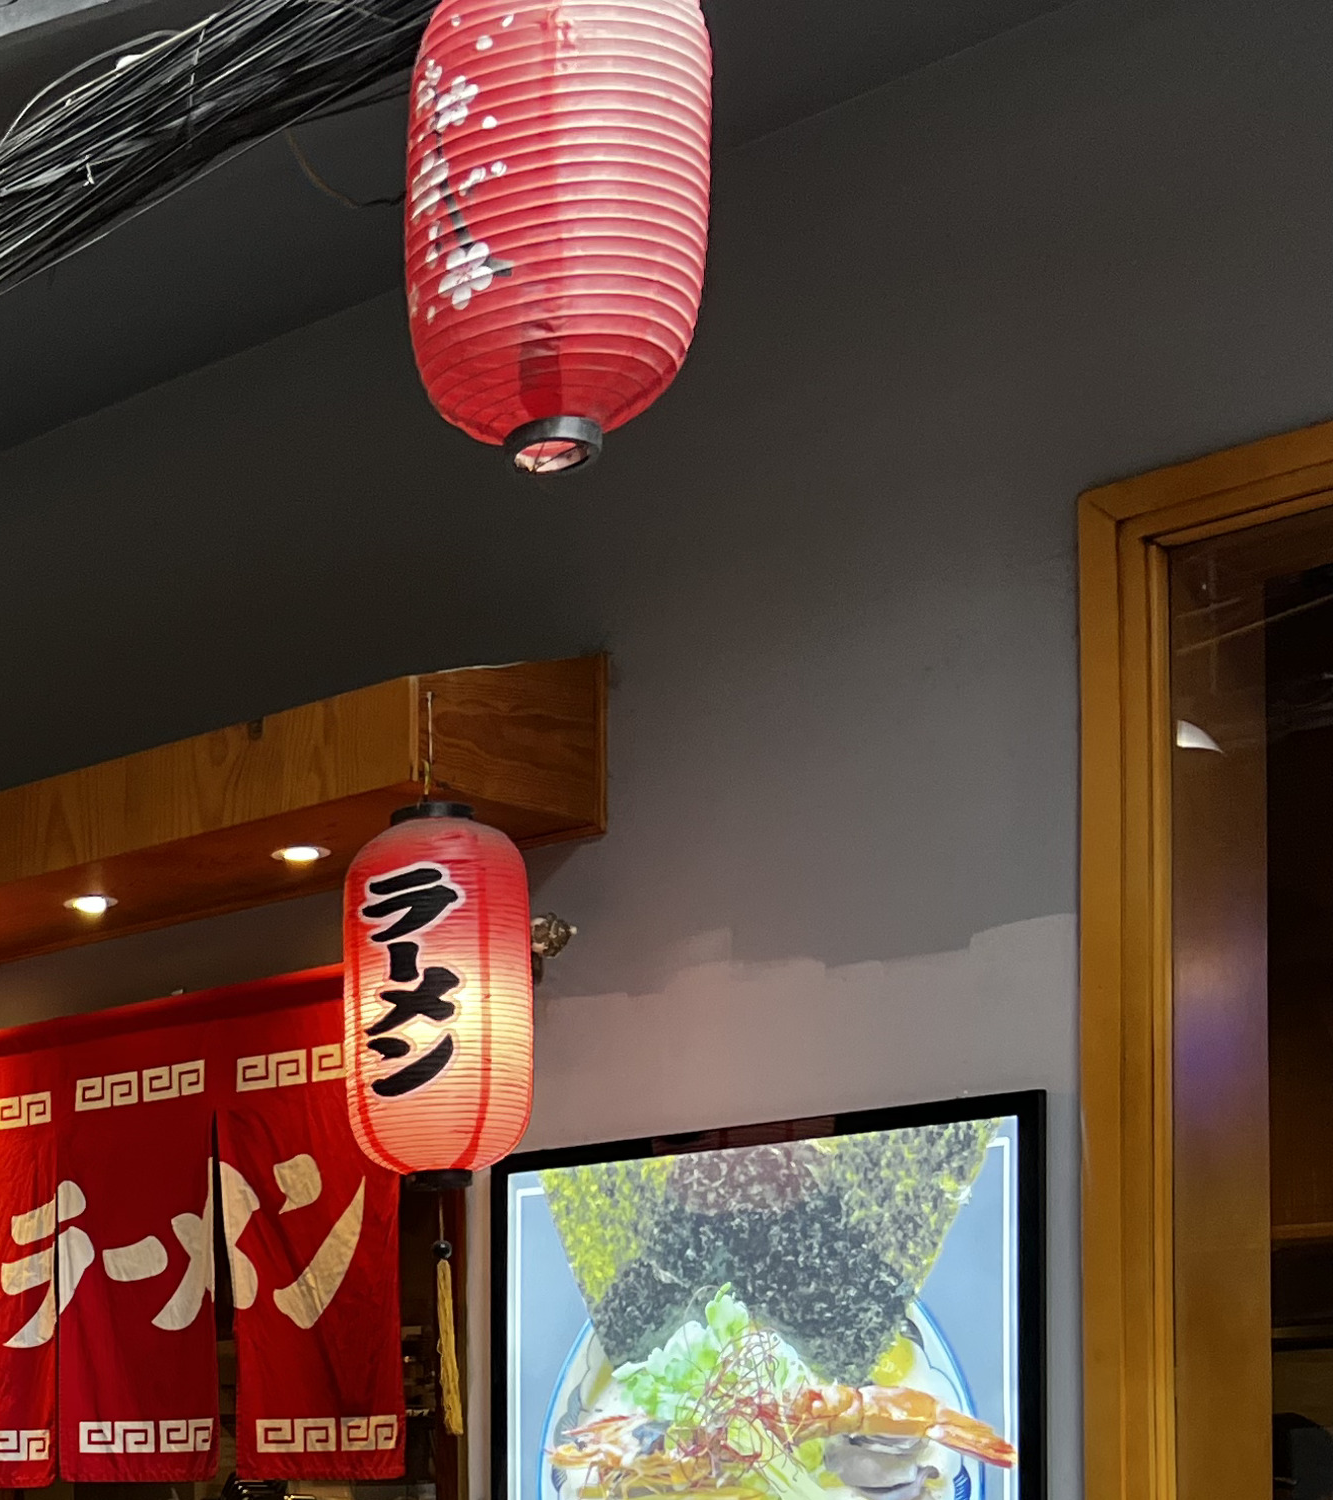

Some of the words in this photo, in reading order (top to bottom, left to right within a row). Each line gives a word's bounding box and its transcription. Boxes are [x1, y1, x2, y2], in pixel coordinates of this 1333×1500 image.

[361, 868, 460, 1098] ラーメン
[1, 1153, 365, 1348] ラーメン
